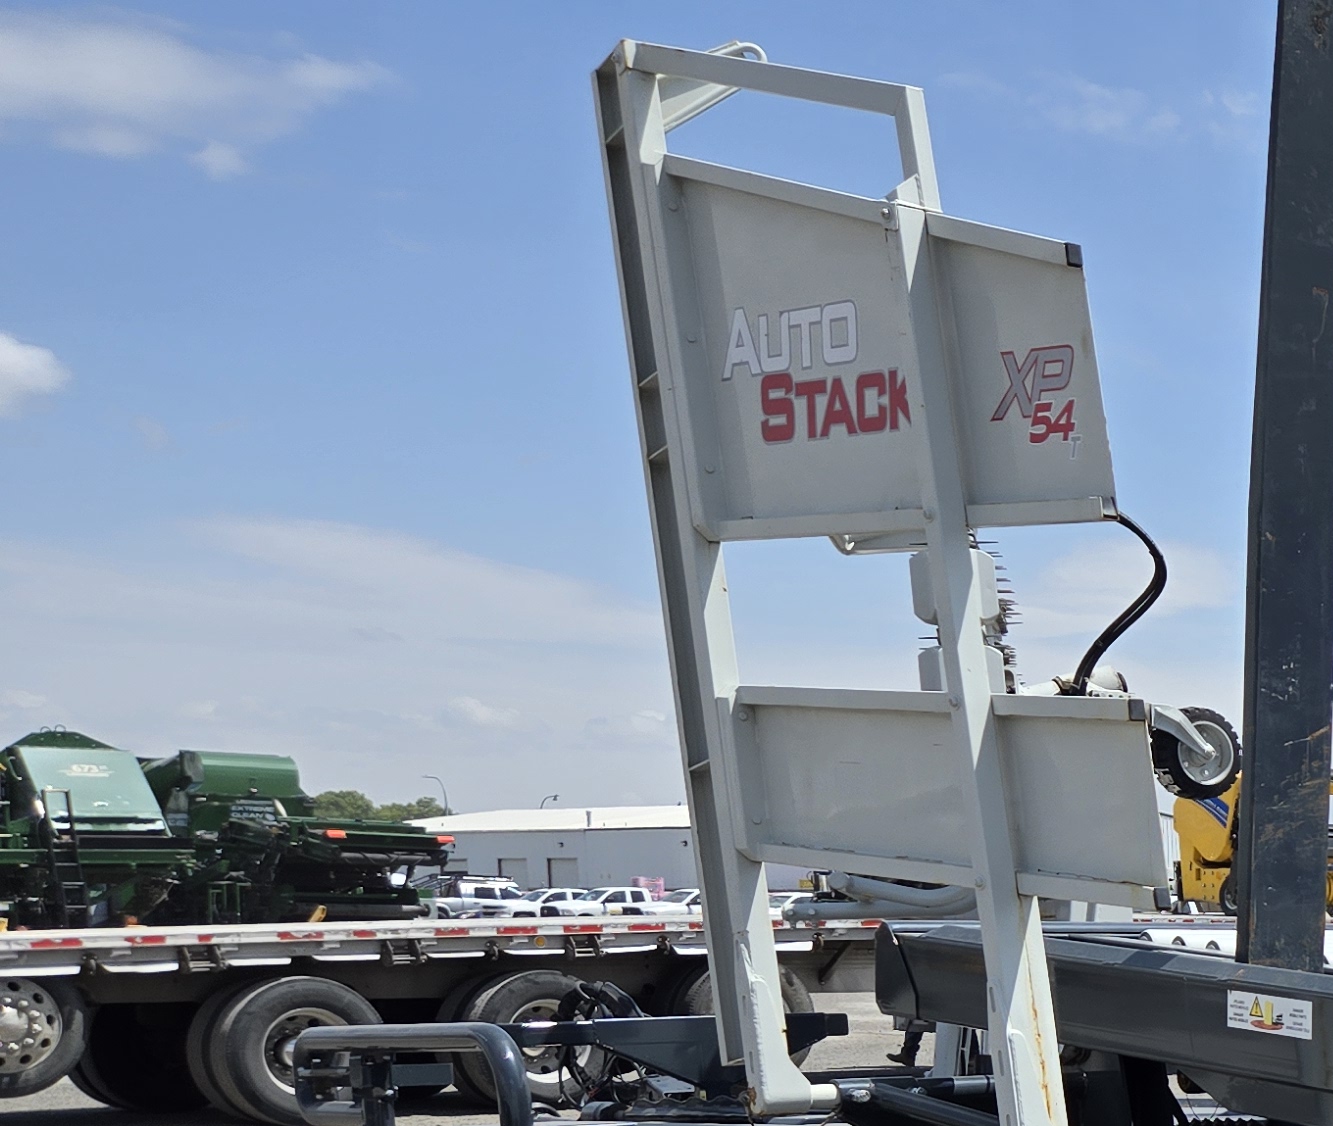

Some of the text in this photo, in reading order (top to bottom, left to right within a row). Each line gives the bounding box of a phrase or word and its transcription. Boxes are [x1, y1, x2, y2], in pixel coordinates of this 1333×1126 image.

[721, 299, 858, 382] AUTO
[760, 366, 912, 444] STACK
[990, 344, 1075, 422] XP
[1028, 397, 1077, 444] 54
